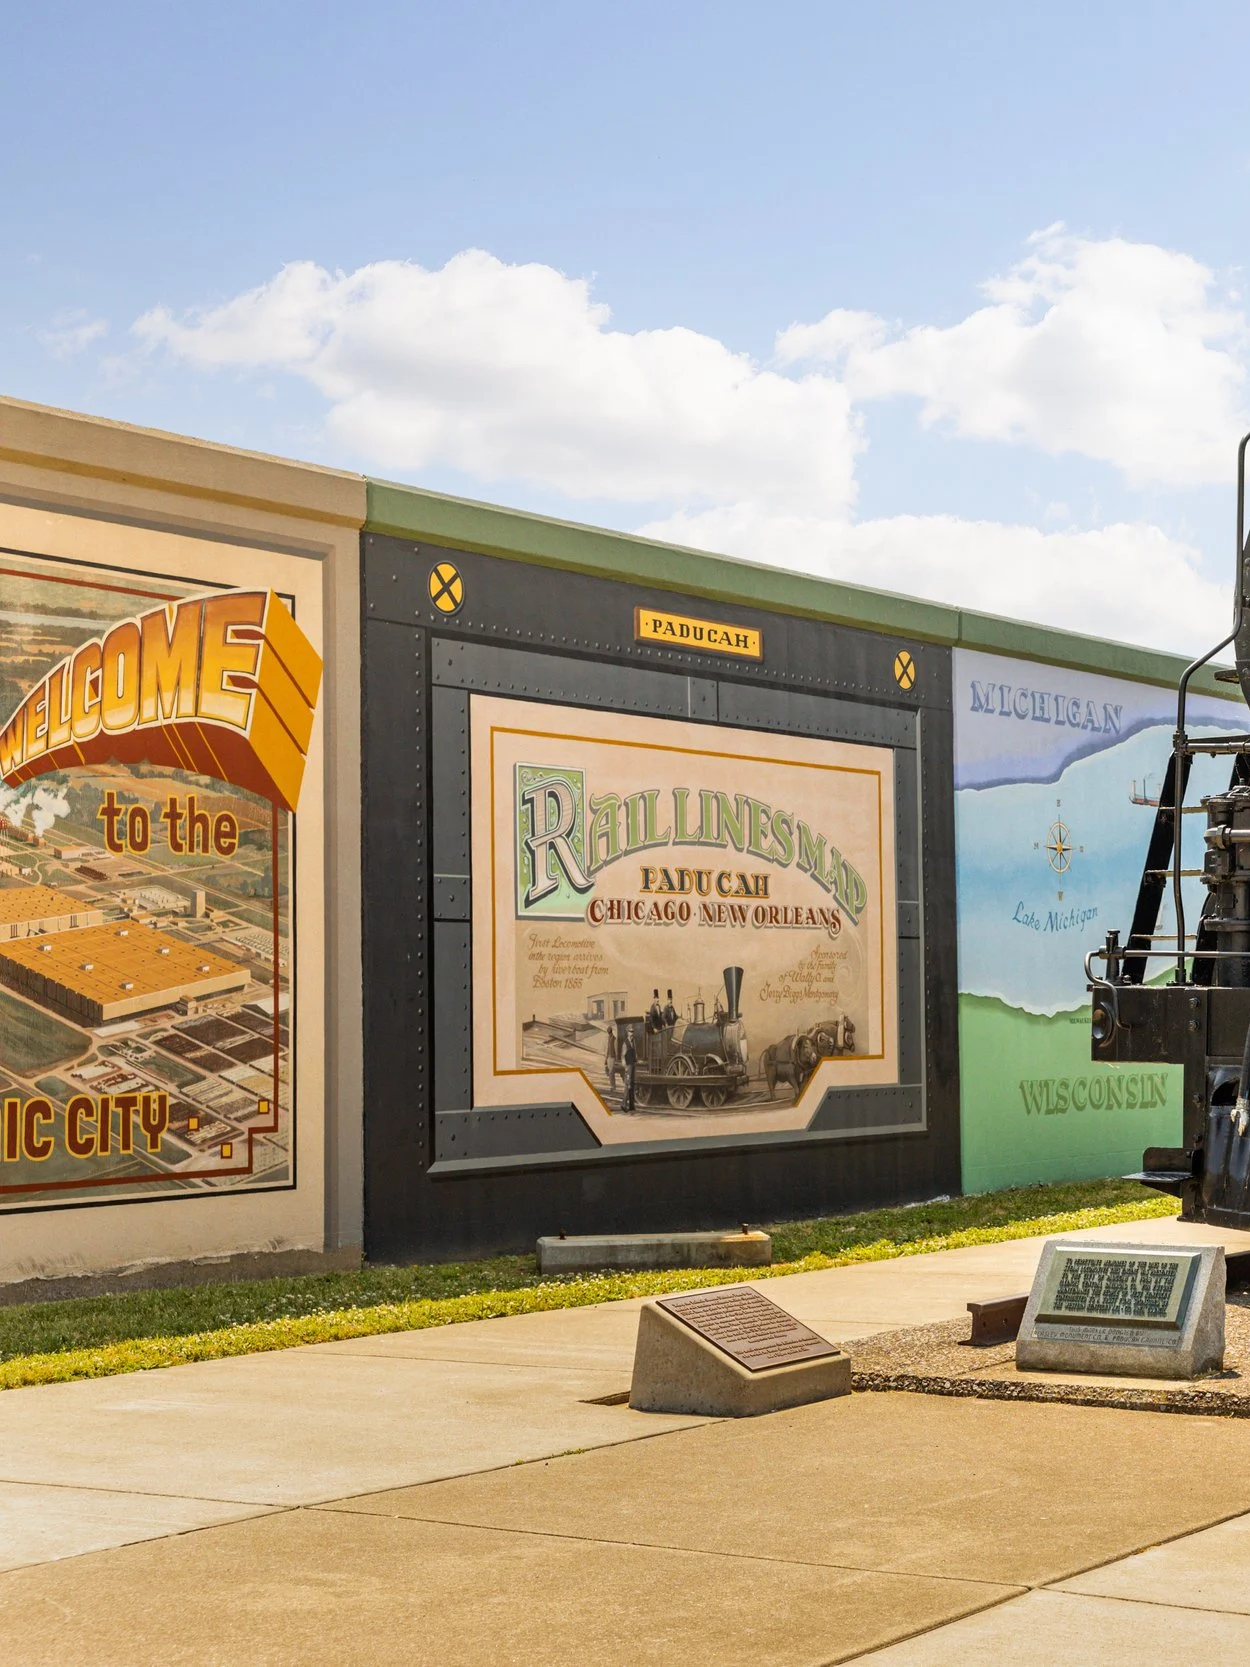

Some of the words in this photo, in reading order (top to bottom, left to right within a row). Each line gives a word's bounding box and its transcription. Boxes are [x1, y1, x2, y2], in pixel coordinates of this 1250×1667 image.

[652, 618, 749, 649] PADUCAH
[0, 588, 270, 780] WELCOME
[970, 680, 1123, 736] MICHIGAN
[98, 790, 151, 857] to
[161, 792, 239, 857] the
[522, 777, 671, 908] RAIL
[672, 787, 795, 866] LINES
[796, 819, 868, 925] MAP
[639, 865, 771, 898] PADUCAH
[586, 899, 692, 927] CHICAGO
[698, 901, 750, 928] NEW
[752, 904, 843, 939] ORLEANS
[1012, 900, 1040, 932] Lake
[1043, 906, 1098, 932] Michigan
[1019, 1072, 1168, 1117] WISCONSIN
[0, 1096, 54, 1162] IC
[65, 1091, 170, 1159] CITY
